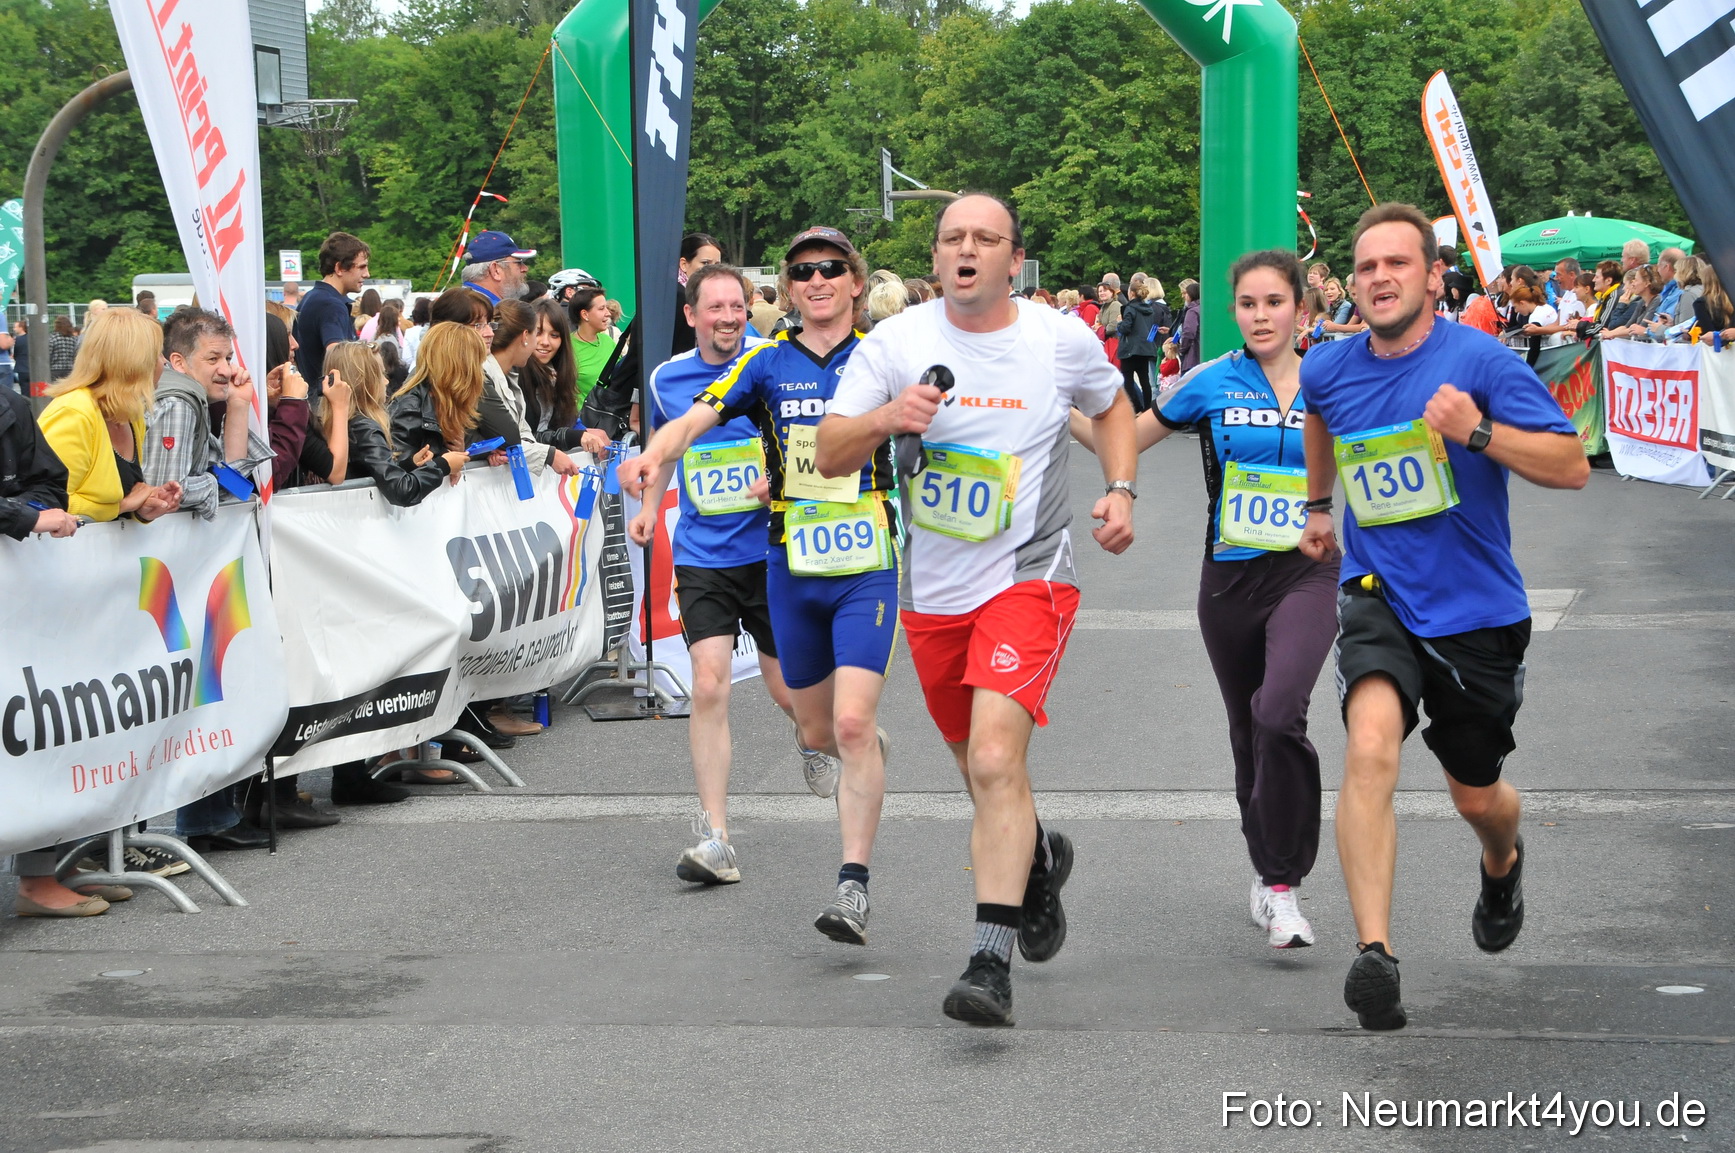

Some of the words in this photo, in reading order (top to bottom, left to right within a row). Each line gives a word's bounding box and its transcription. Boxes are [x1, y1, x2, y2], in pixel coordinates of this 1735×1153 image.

[1434, 97, 1478, 216] KLEBL
[778, 382, 818, 391] TEAM
[960, 396, 1028, 410] KLEBL
[1224, 391, 1269, 399] TEAM
[1223, 407, 1306, 429] BOC
[1611, 370, 1694, 444] MEIER
[796, 439, 816, 449] spo
[690, 464, 759, 497] 1250
[921, 471, 991, 518] 510
[1353, 455, 1425, 501] 130
[932, 510, 957, 523] Stefan
[1228, 493, 1308, 530] 1083
[793, 520, 874, 557] 1069
[1243, 526, 1263, 536] Rina
[805, 557, 829, 567] Franz
[830, 554, 853, 564] Xaver
[446, 521, 564, 642] swn
[2, 657, 194, 757] chmann
[355, 699, 374, 719] die
[376, 688, 436, 716] verbinden
[71, 751, 140, 794] Druck
[160, 727, 235, 766] Medien
